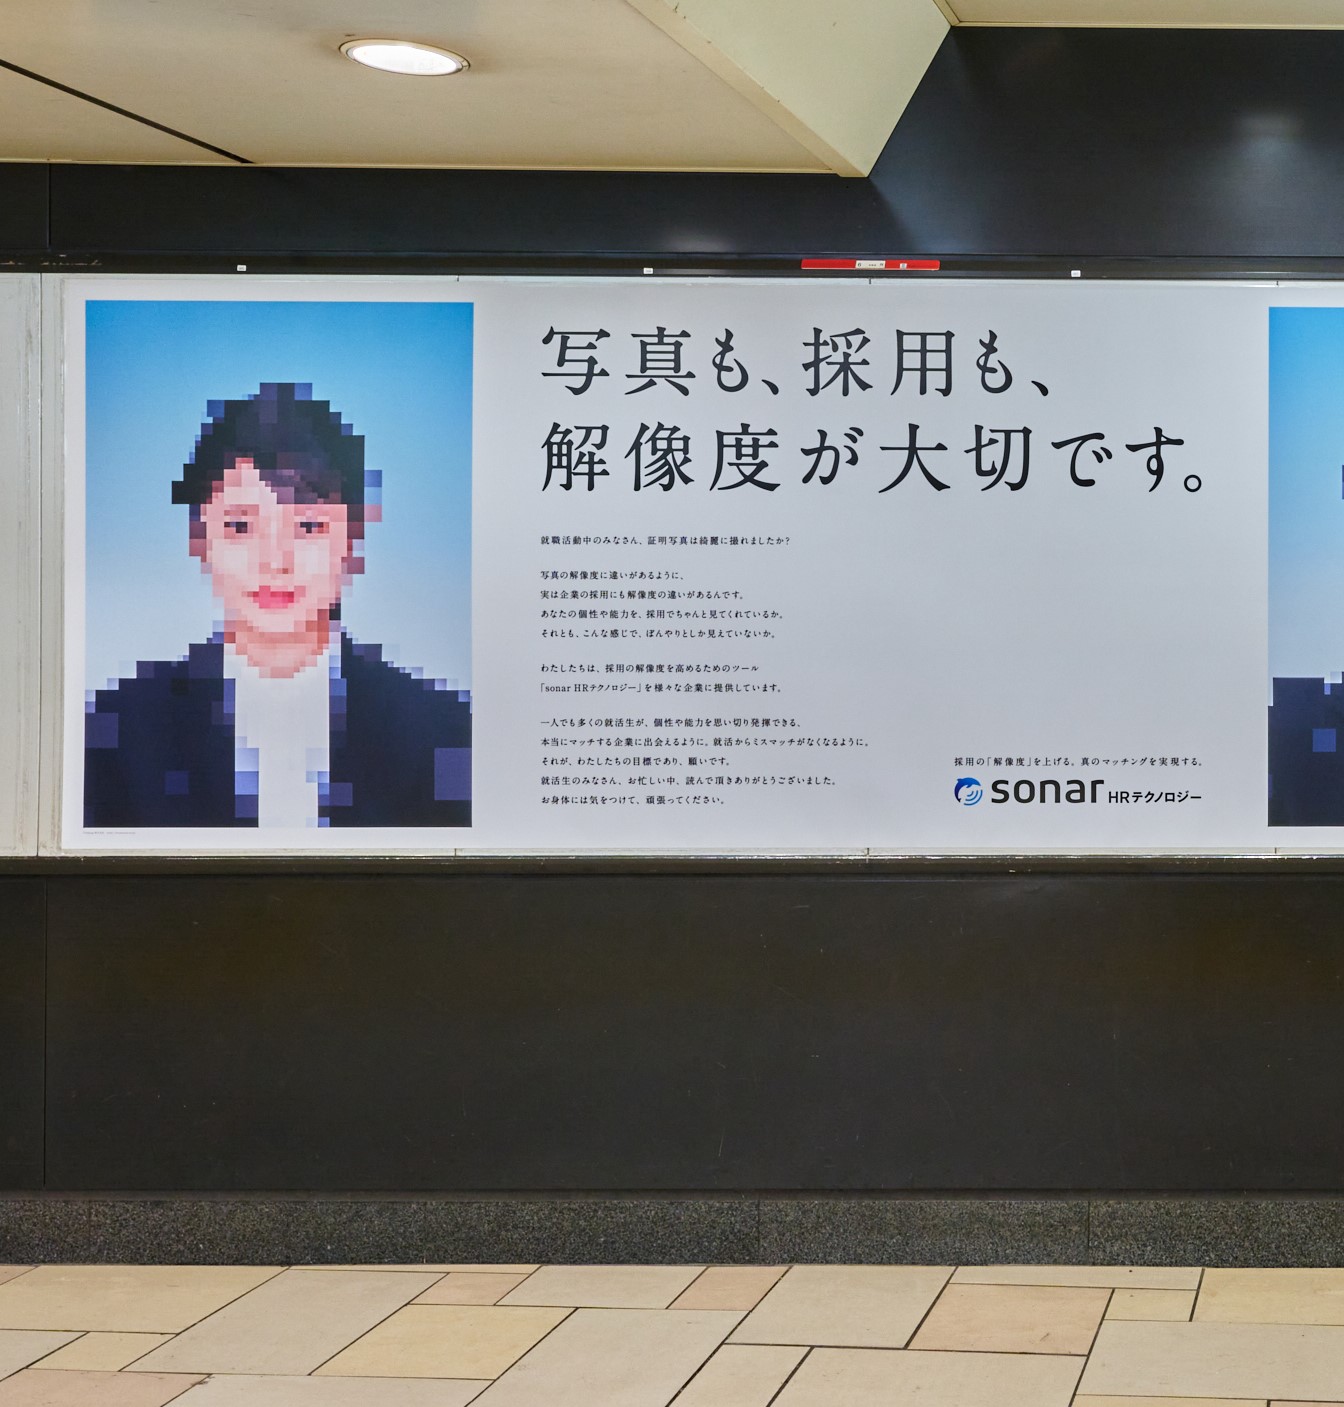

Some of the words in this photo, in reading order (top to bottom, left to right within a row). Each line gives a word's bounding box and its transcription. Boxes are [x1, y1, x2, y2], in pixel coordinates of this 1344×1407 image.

[541, 326, 1050, 397] 写真も、採用も、
[541, 422, 1202, 494] 解像度が大切です。
[540, 570, 685, 580] 写真の解像度に違いがあるように、
[540, 590, 744, 600] 実は企業の採用にも解像度の違いがあるんです。
[540, 609, 785, 619] あなたの個性や能力を、採用でちゃんと見てくれているか。
[540, 629, 776, 639] それとも、こんな感じで、ぼんやりとしか見えていないか。
[540, 664, 760, 674] わたしたちは、採用の解像度を高めるためのツール
[541, 756, 730, 766] それが、わたしたちの目標であり、願いです。
[991, 779, 1104, 804] sonar
[1108, 790, 1202, 804] HRテクノロジー
[541, 795, 726, 805] お身体には気をつけて、頑張ってください。
